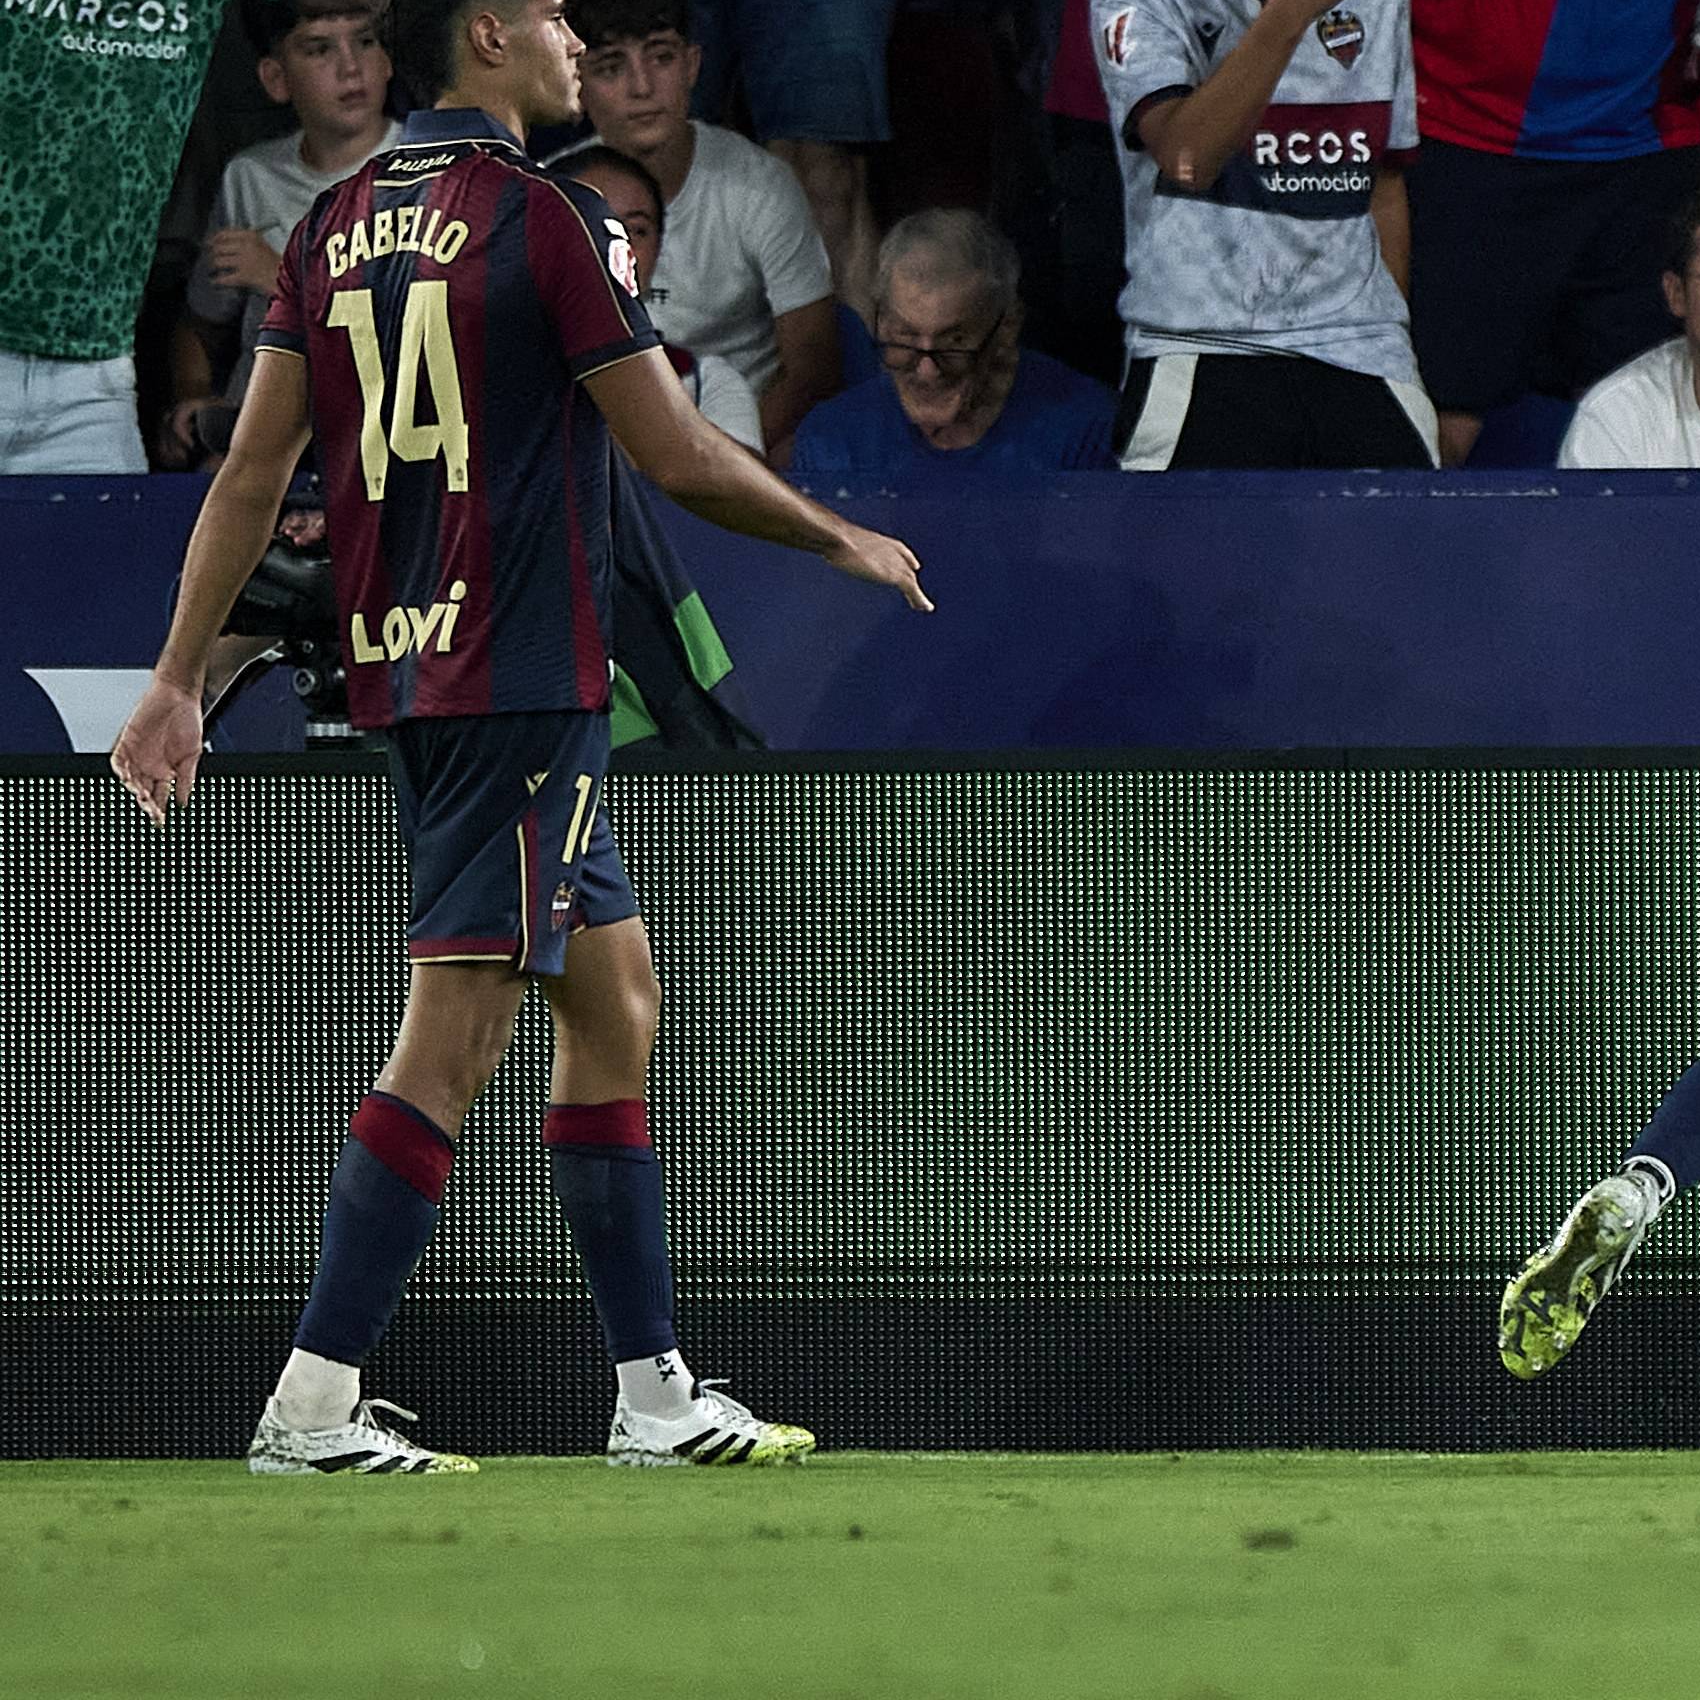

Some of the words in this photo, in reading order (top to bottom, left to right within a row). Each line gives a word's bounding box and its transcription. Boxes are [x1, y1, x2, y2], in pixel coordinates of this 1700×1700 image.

[1255, 131, 1371, 166] RCOS
[1262, 170, 1371, 193] utomoción
[325, 205, 469, 279] CABELLO
[328, 279, 470, 503] 14
